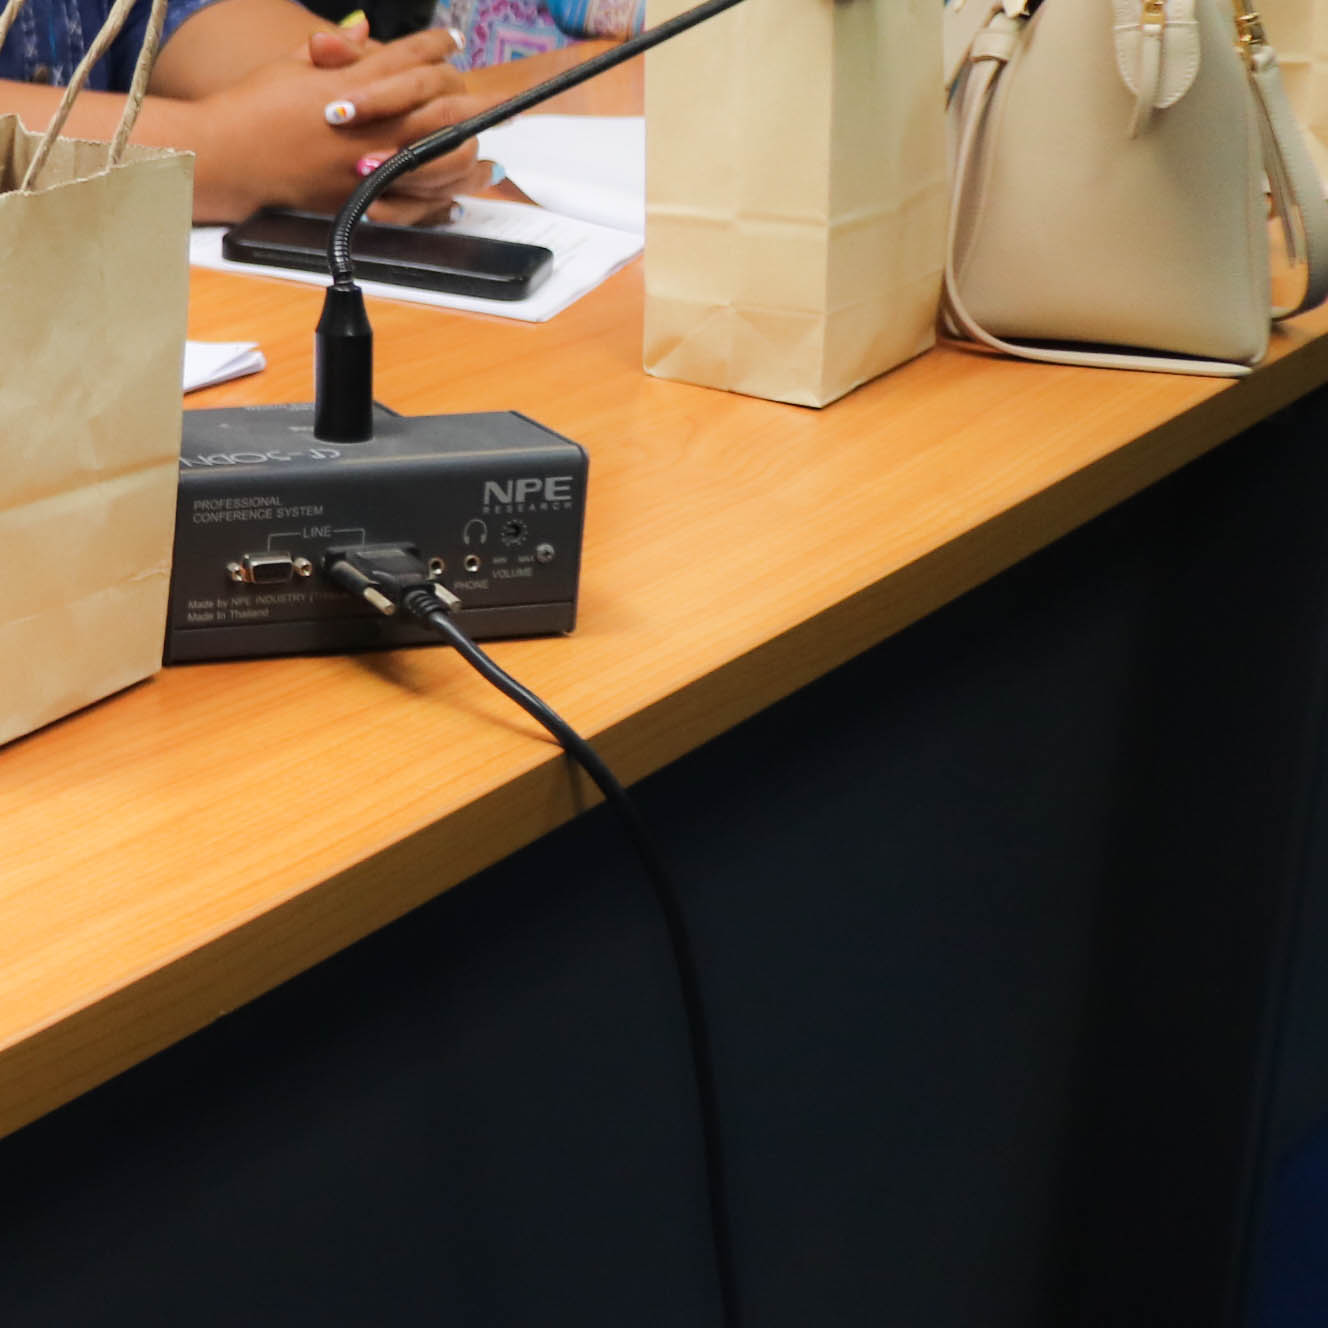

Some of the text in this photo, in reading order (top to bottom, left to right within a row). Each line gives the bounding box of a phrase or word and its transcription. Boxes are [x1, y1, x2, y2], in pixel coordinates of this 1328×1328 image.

[484, 476, 573, 505] NPE
[193, 496, 282, 511] PROFESSIONAL
[482, 502, 573, 514] RESEARCH
[193, 506, 323, 523] CONFERENCE SYSTEM
[302, 527, 332, 539] LINE
